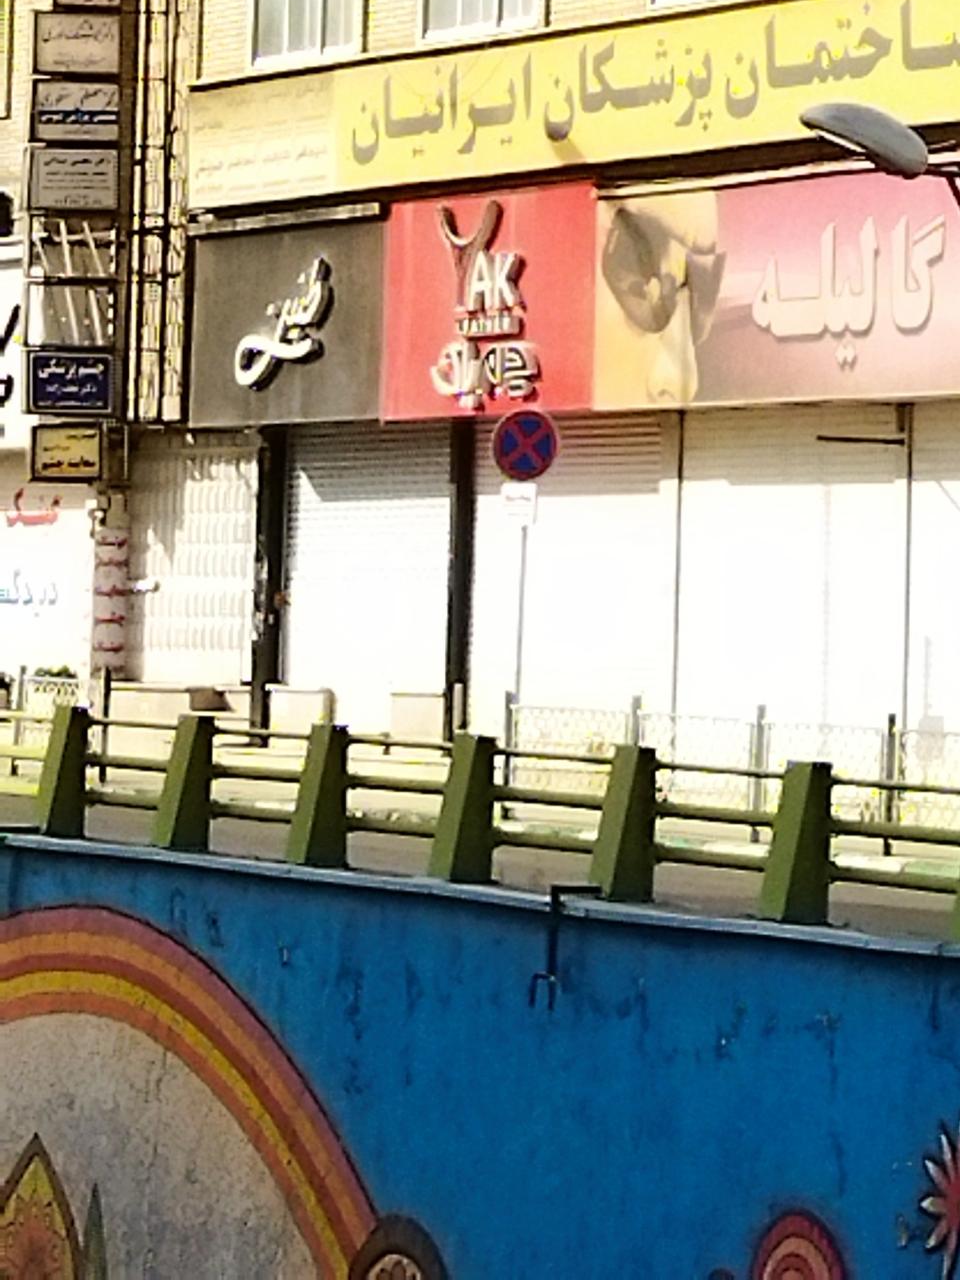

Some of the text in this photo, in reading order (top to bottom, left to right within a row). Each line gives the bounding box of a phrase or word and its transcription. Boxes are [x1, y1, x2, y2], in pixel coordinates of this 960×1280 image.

[351, 52, 532, 166] ایرانیان
[543, 39, 713, 142] پزشکان
[436, 200, 526, 312] YAK
[751, 213, 946, 370] گالیله
